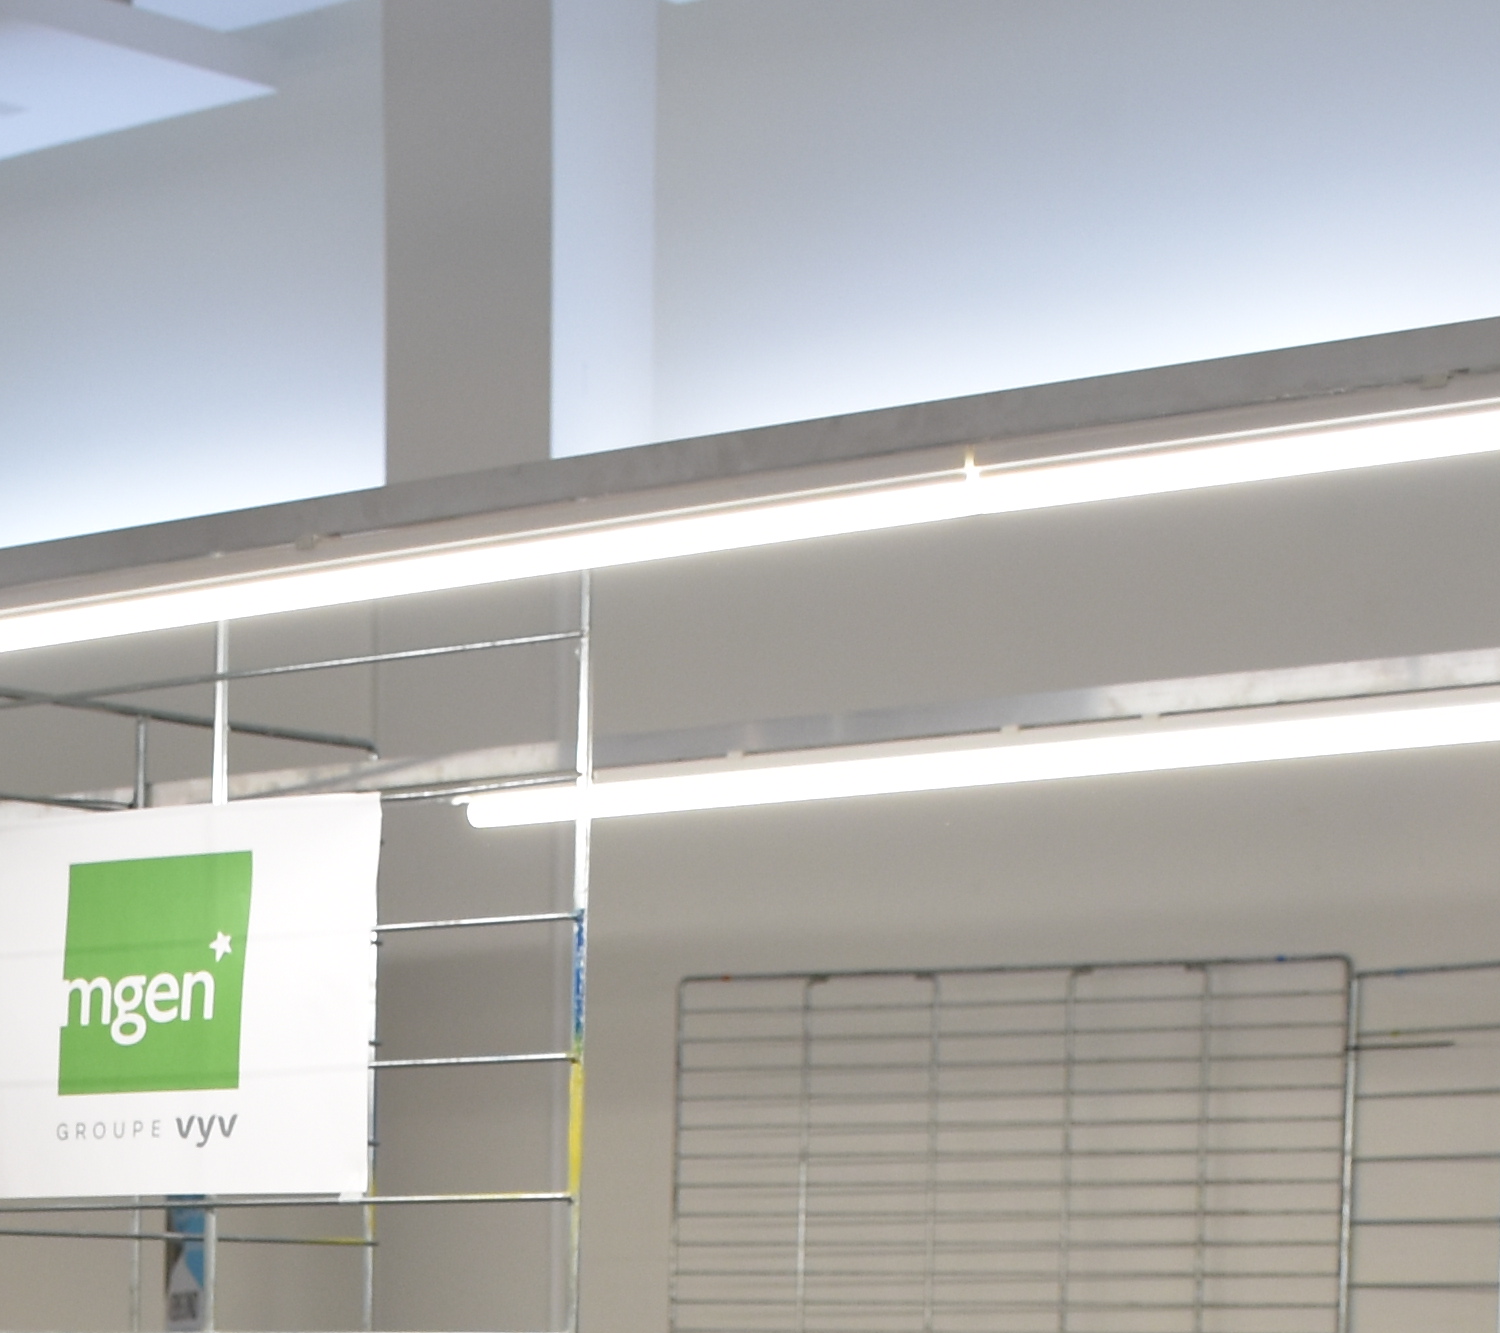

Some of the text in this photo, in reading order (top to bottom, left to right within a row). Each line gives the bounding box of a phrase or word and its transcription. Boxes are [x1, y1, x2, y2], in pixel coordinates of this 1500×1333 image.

[60, 970, 217, 1046] mgen
[56, 1113, 239, 1148] GROUPE vyv
